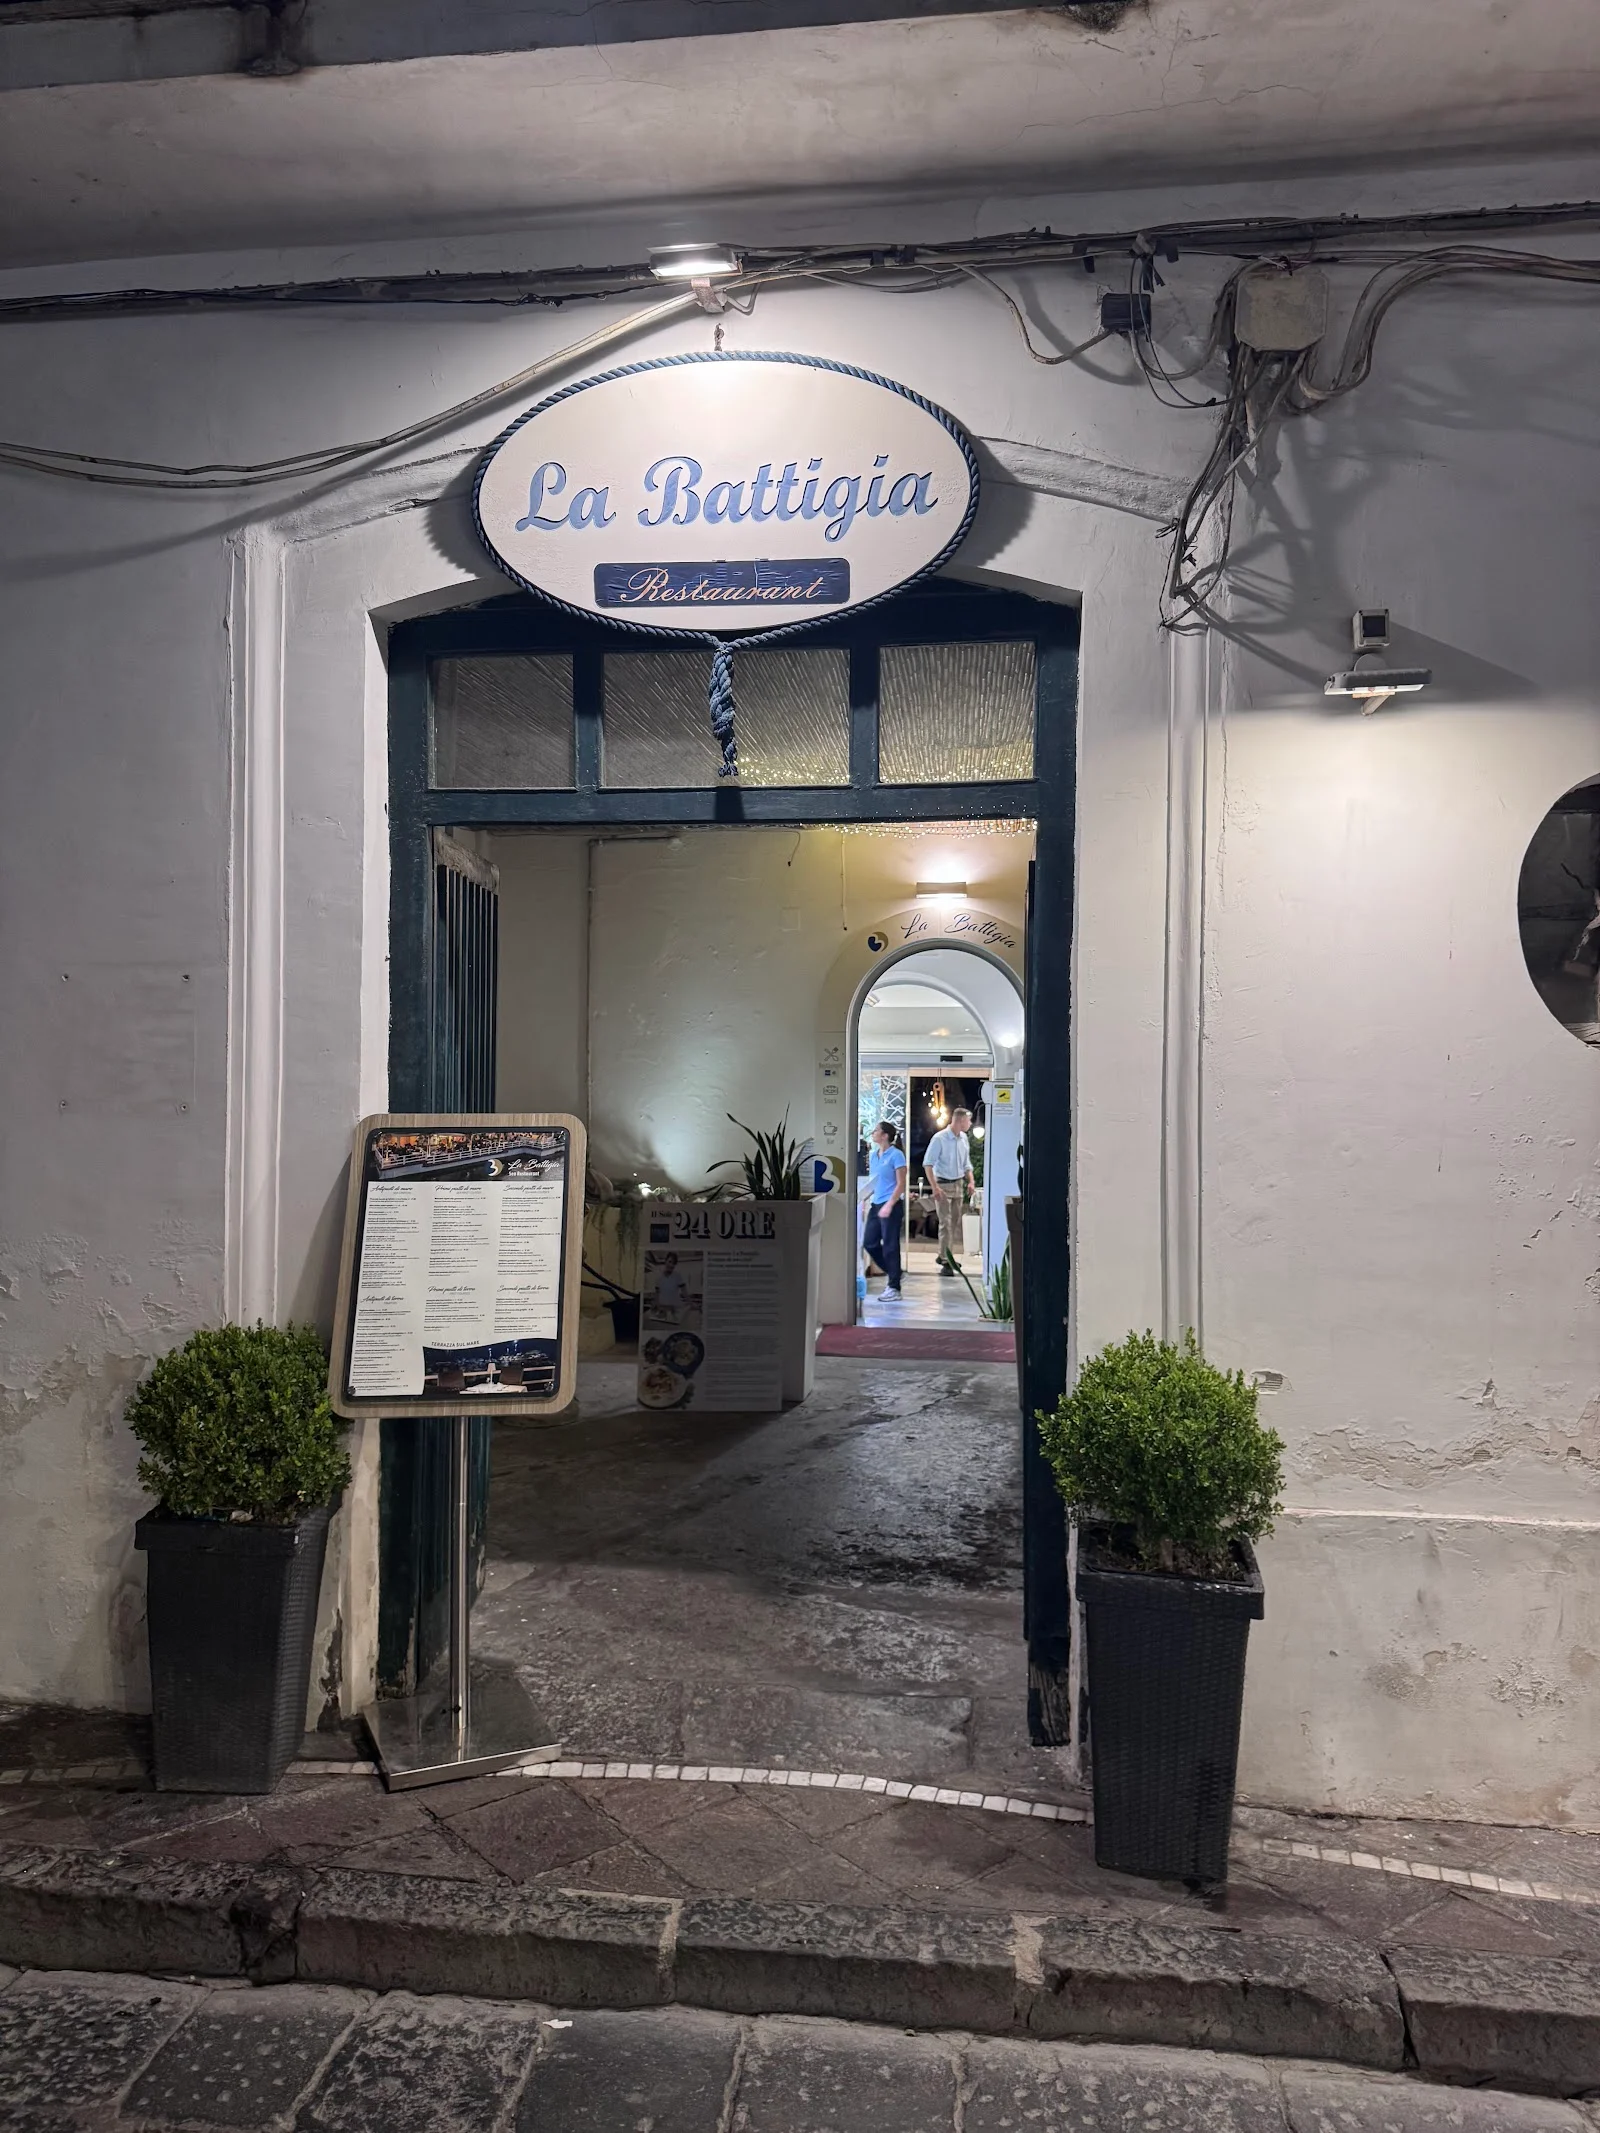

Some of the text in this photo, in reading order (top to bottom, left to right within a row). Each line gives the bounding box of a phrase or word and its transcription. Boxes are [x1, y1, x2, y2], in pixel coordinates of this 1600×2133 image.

[515, 454, 939, 543] La Battigia
[620, 567, 826, 603] Restaurant
[901, 913, 1017, 949] La Battigia
[507, 1158, 560, 1172] La Battigia
[673, 1209, 711, 1239] 24
[715, 1209, 775, 1239] ORE
